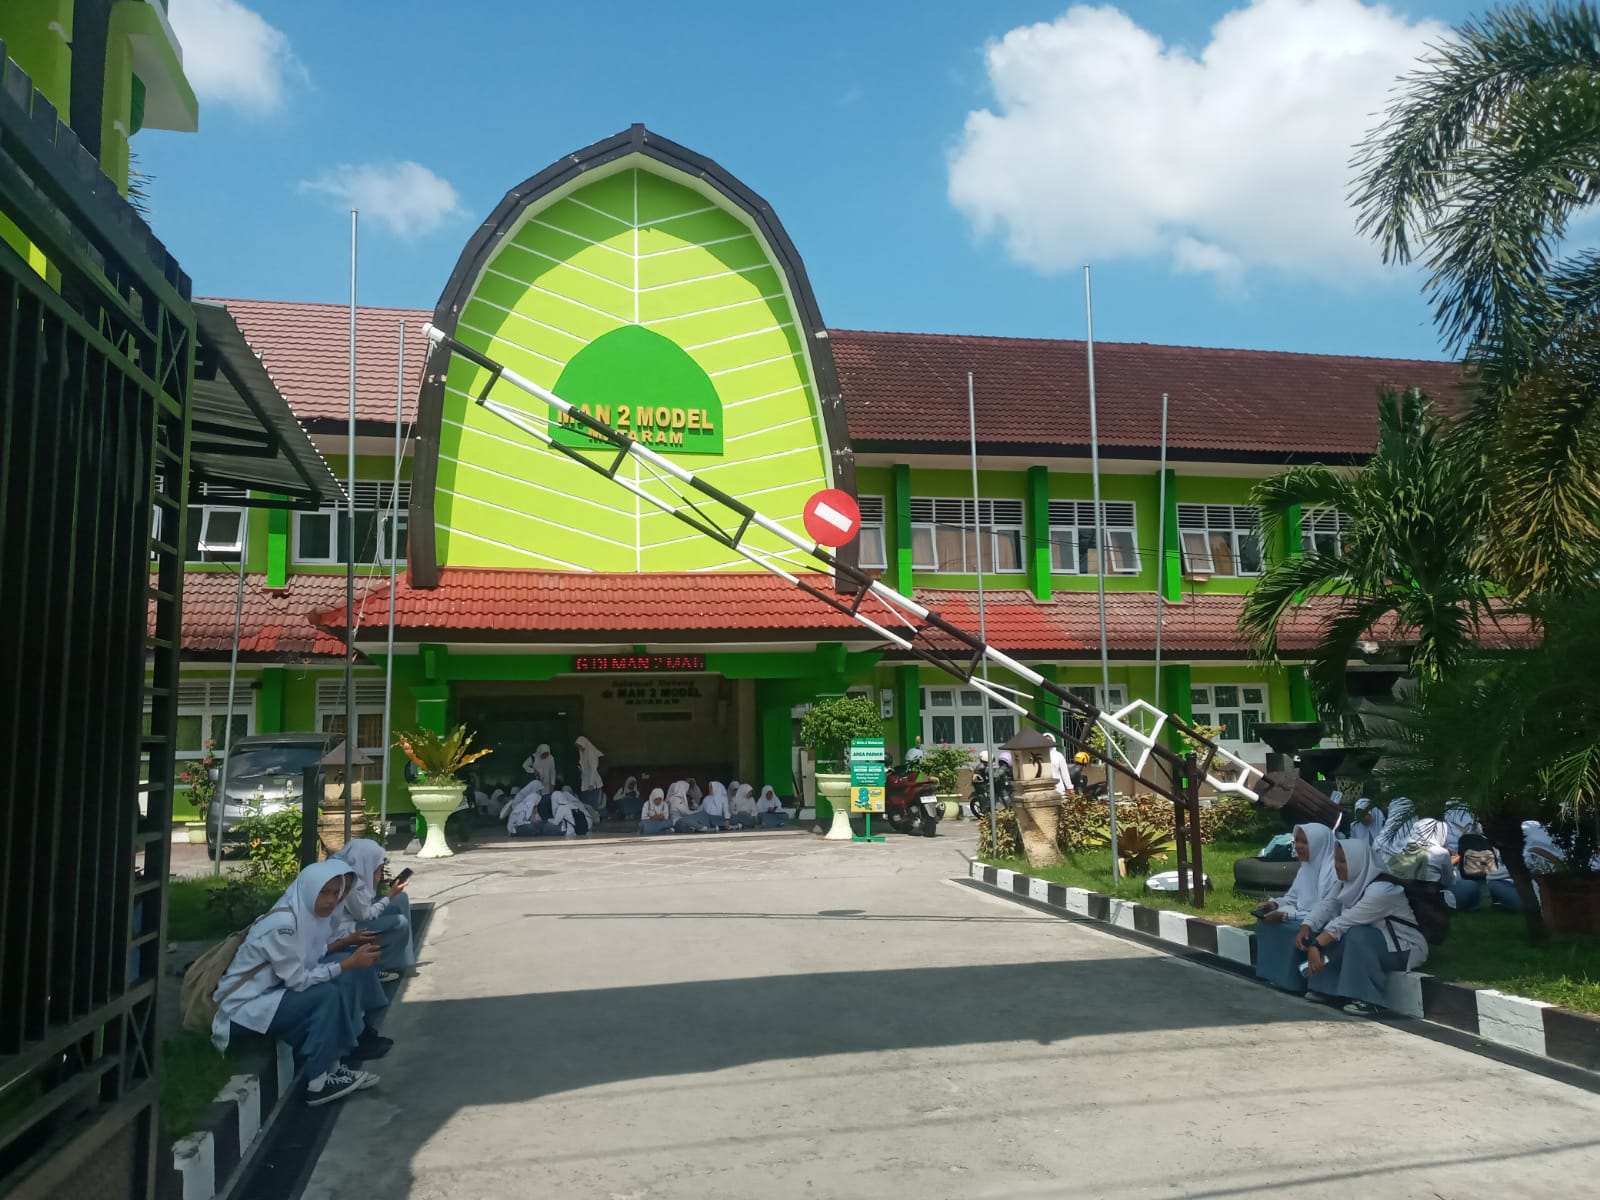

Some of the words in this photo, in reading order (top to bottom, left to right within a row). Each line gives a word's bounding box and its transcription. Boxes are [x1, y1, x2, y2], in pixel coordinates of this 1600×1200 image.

[617, 405, 631, 426] 2
[636, 406, 714, 430] MODEL
[612, 657, 650, 669] MAN
